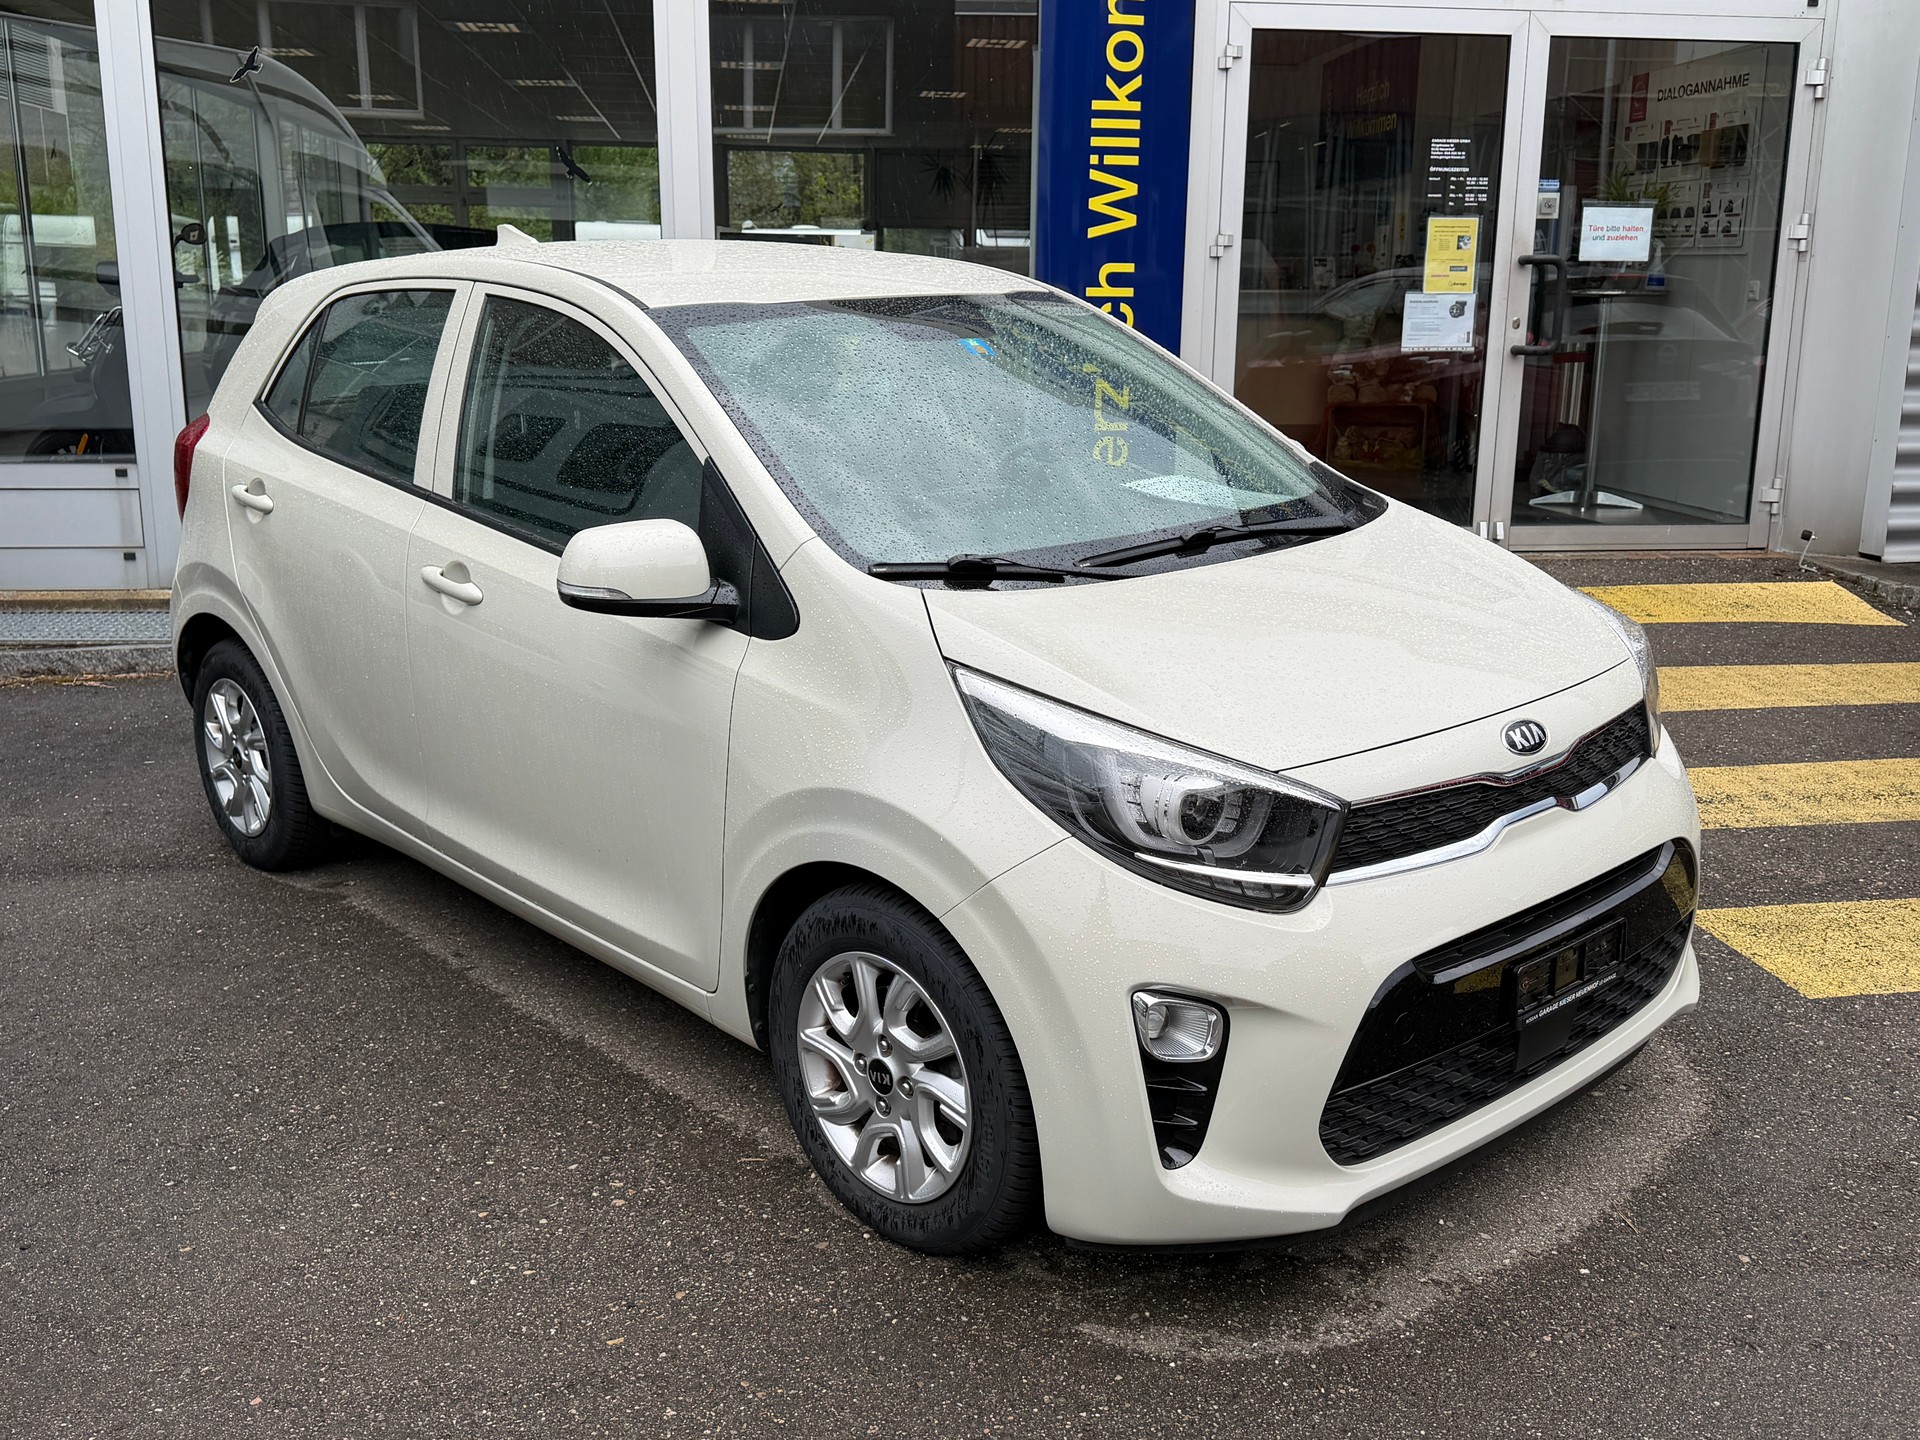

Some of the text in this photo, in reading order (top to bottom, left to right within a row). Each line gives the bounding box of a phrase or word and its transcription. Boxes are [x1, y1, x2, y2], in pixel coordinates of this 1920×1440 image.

[1656, 72, 1751, 102] DIALOGANNAHME
[1588, 224, 1644, 232] Türe bitte halten
[1507, 722, 1546, 750] KIA
[1538, 1001, 1559, 1017] GARAGE
[1559, 993, 1576, 1007] KIESER
[869, 1069, 891, 1086] KIA
